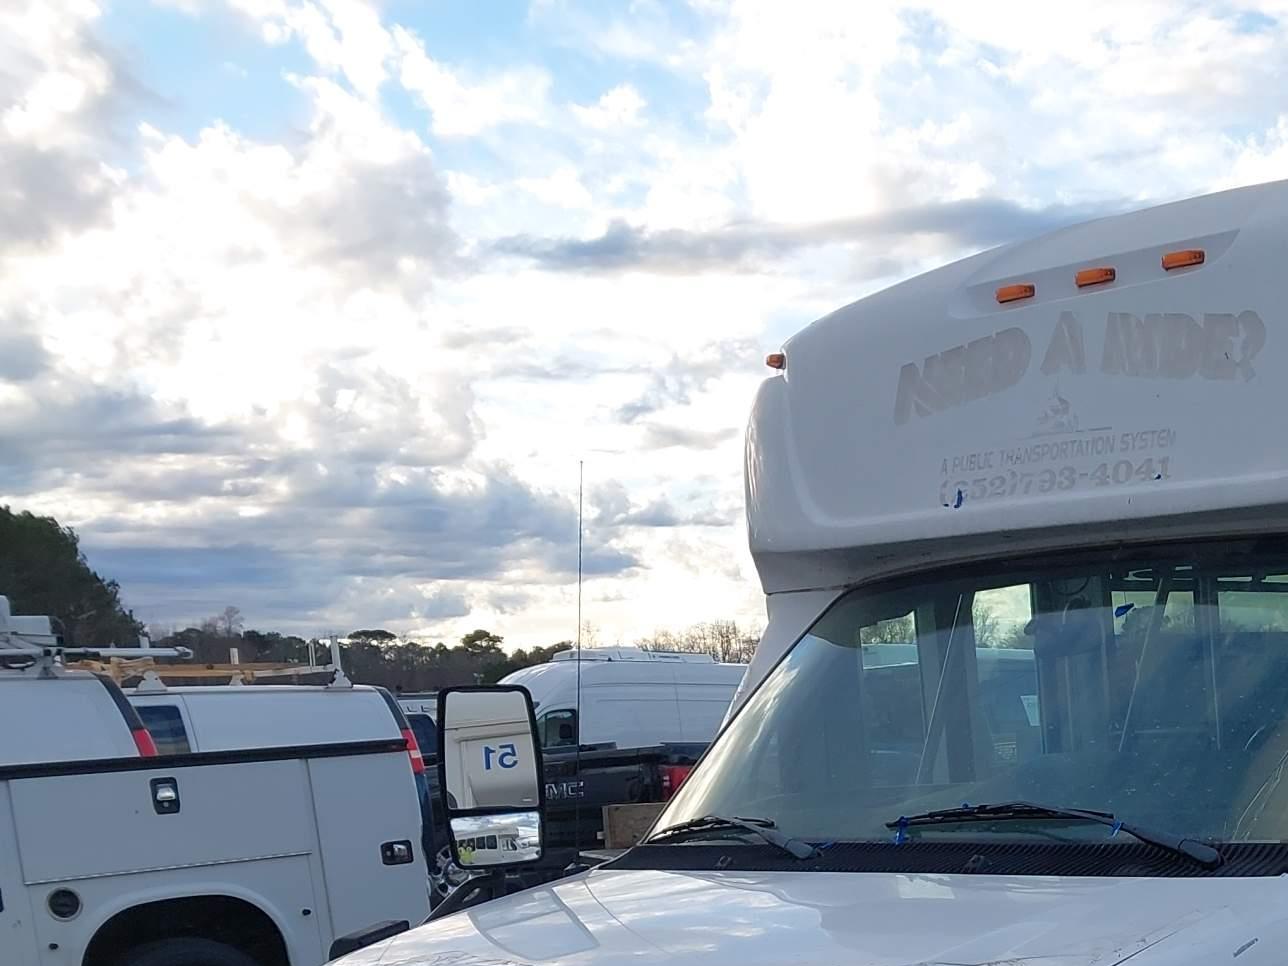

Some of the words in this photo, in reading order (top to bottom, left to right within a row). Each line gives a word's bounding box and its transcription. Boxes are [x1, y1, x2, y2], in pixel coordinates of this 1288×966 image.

[893, 327, 1032, 426] NEED
[1040, 310, 1087, 376] A
[1100, 310, 1267, 383] RIDE?
[940, 458, 948, 476] A
[952, 453, 993, 473] PUBLIC
[1000, 436, 1116, 466] TRANSPORTATION
[1119, 429, 1177, 452] SYSTEM
[545, 781, 584, 800] MC
